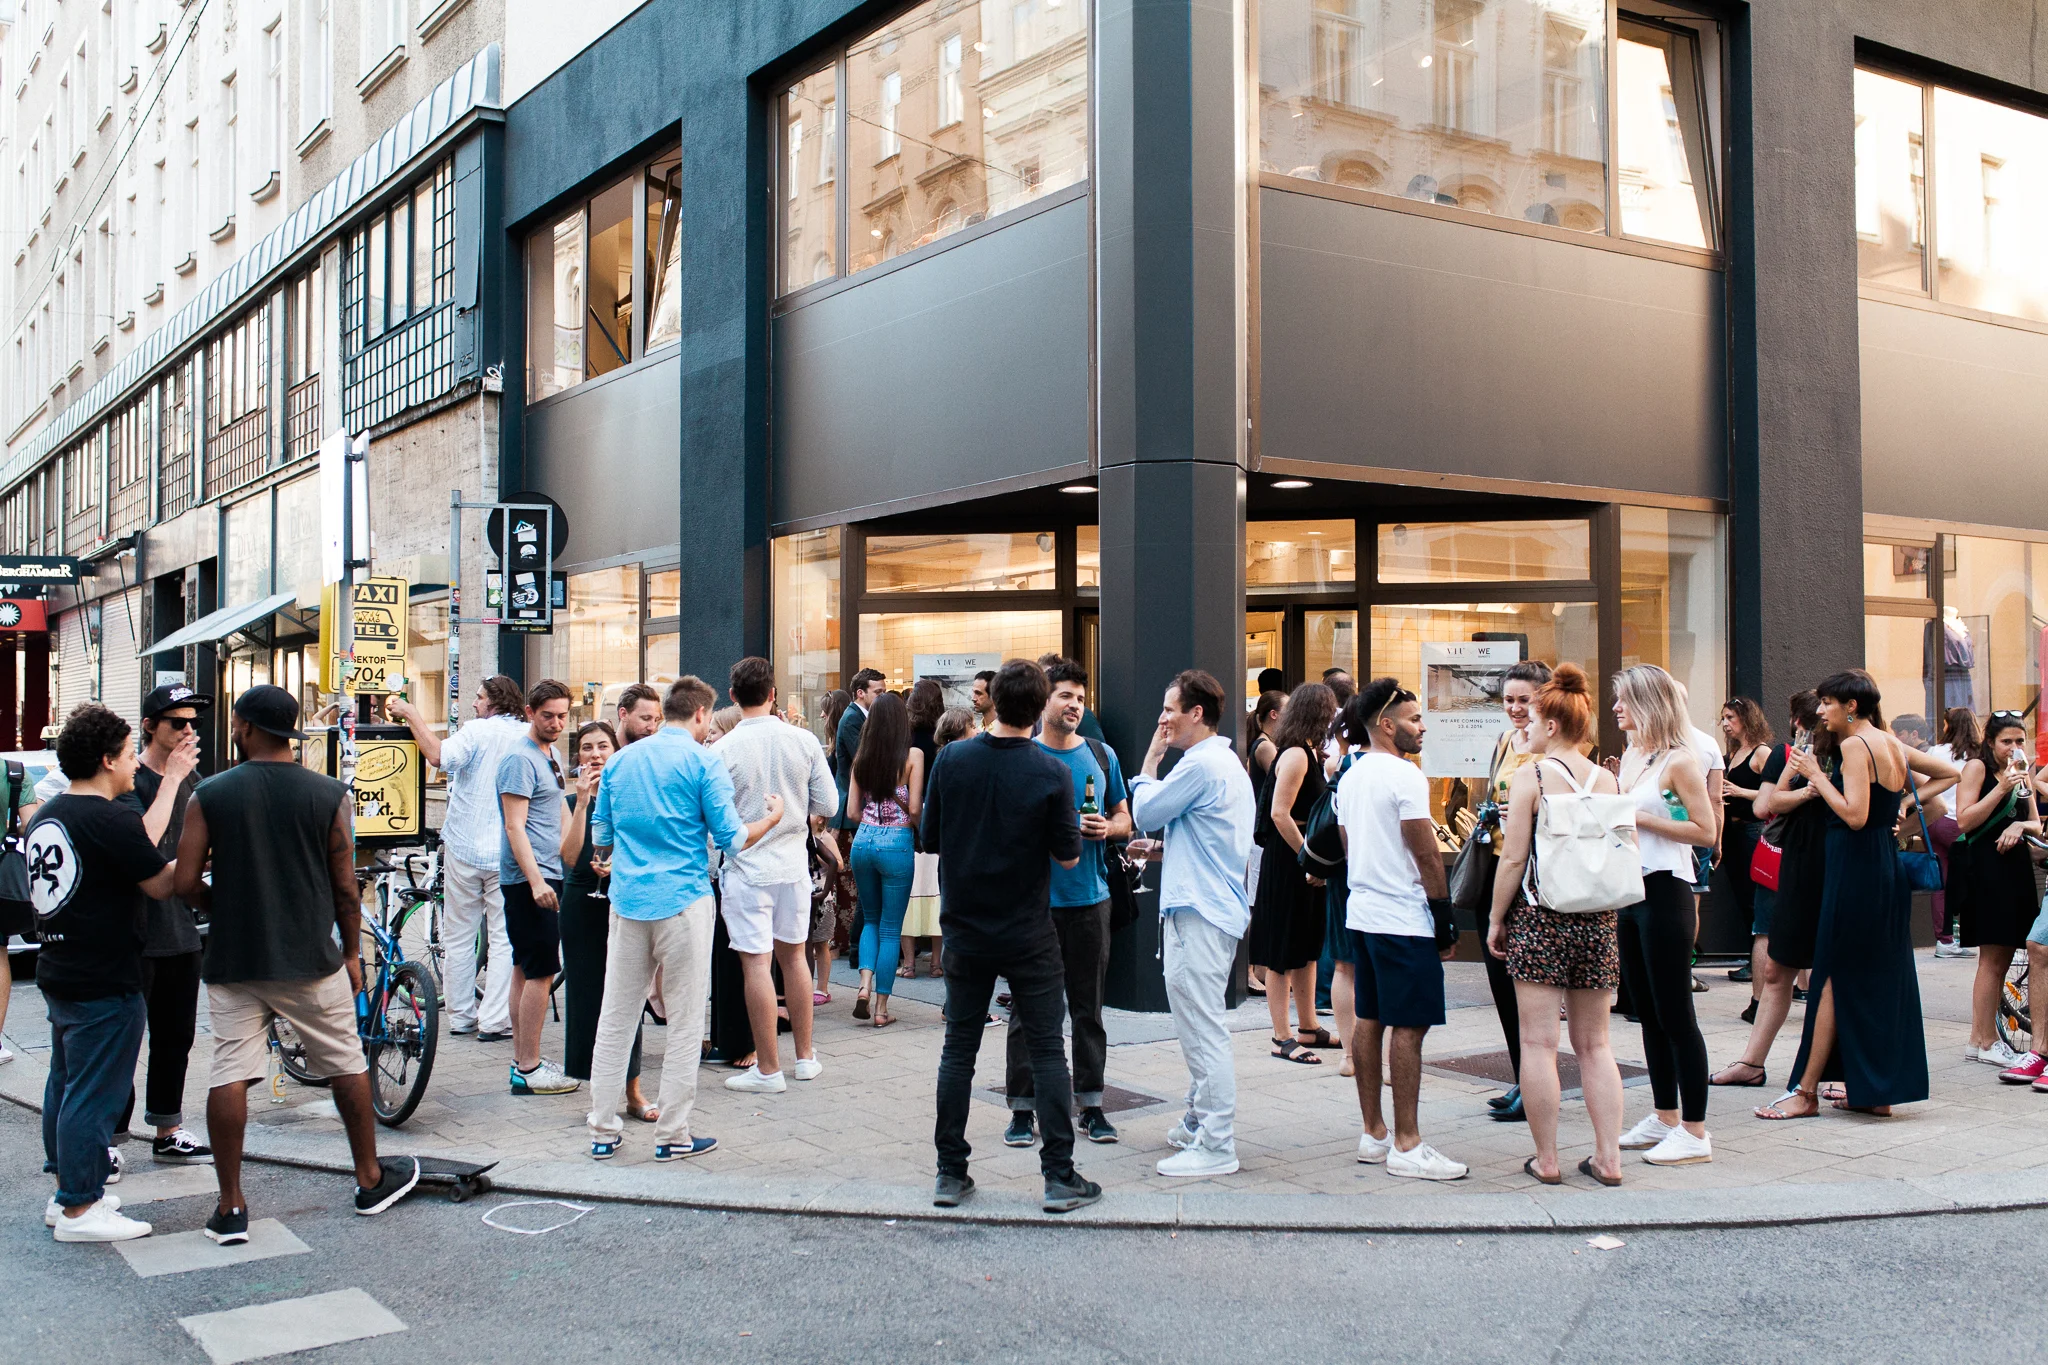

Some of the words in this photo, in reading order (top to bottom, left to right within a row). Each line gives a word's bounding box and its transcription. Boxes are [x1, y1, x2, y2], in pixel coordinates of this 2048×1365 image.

[0, 564, 73, 577] ERGHAMMER
[355, 624, 385, 635] TEL
[1478, 647, 1491, 655] WE
[354, 667, 386, 682] 704
[354, 787, 385, 802] Taxi
[354, 802, 394, 816] irkt.
